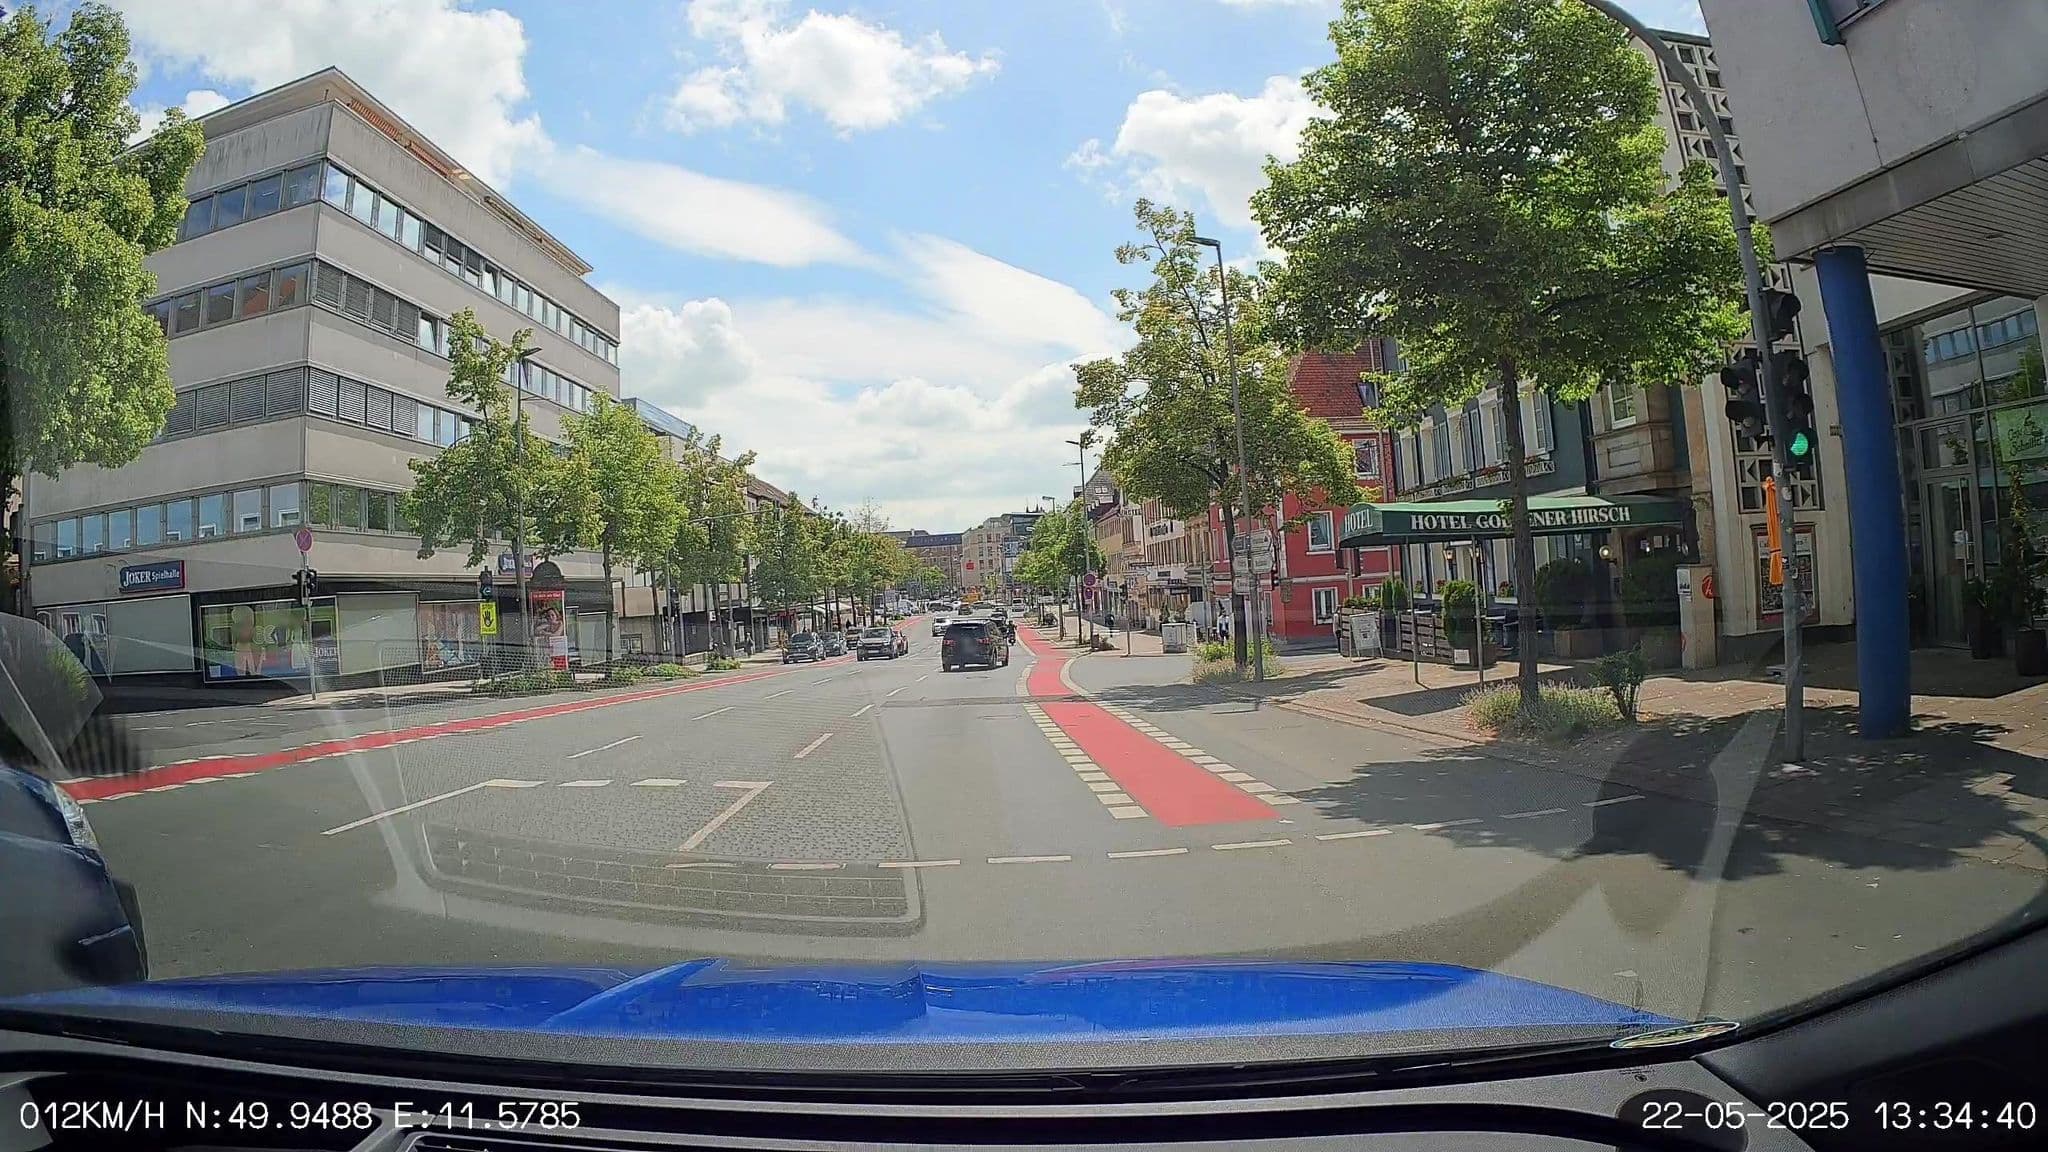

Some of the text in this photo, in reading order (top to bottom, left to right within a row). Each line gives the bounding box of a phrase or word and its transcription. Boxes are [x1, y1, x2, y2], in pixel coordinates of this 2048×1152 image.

[1344, 508, 1373, 534] HOTEL
[1411, 514, 1472, 531] HOTEL
[1571, 506, 1631, 525] HIRSCH
[123, 571, 152, 587] JOKER
